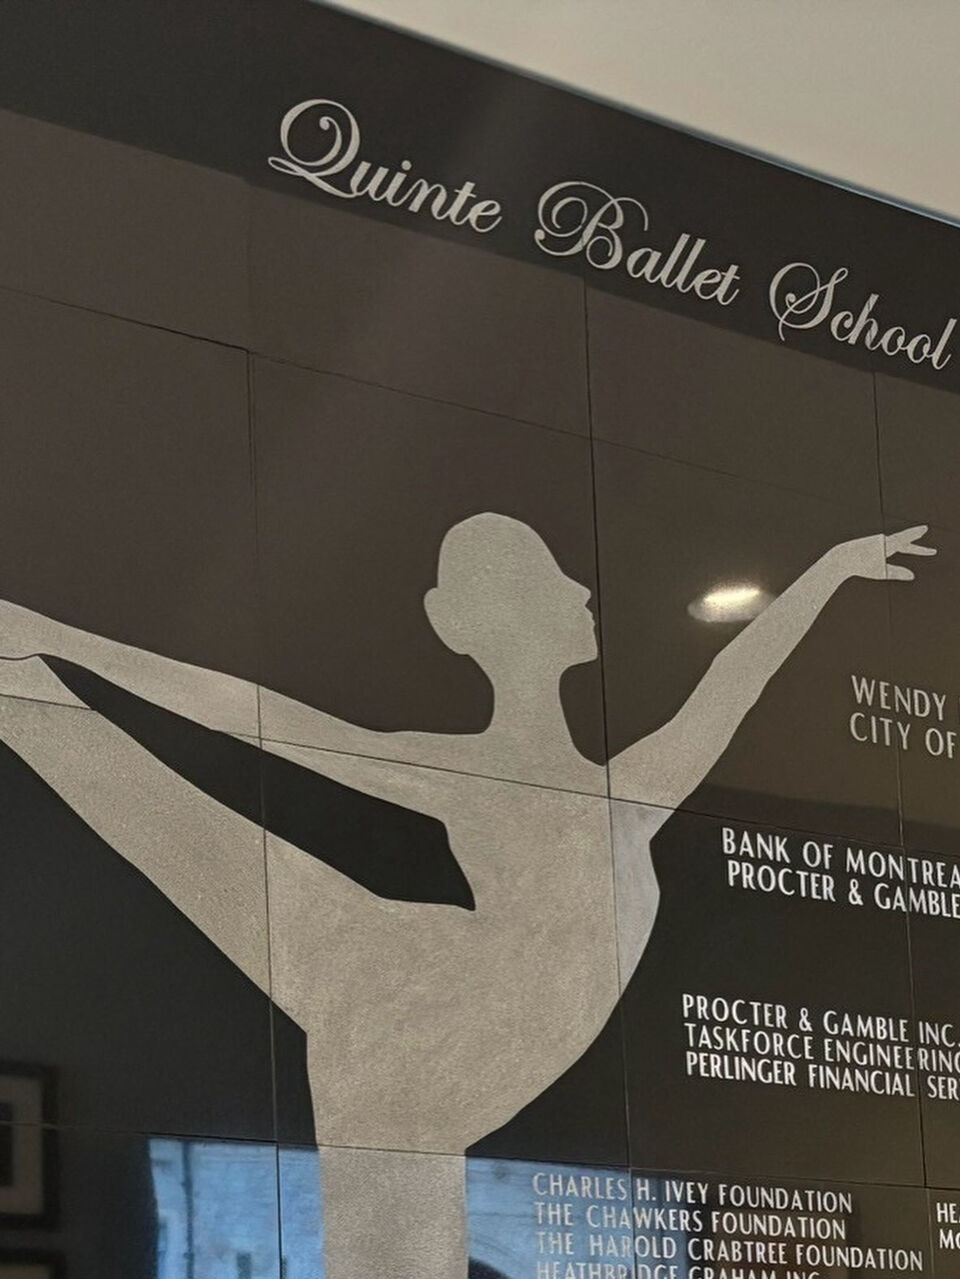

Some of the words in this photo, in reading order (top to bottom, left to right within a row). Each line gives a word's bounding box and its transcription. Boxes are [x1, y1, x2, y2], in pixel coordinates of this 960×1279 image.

[268, 99, 501, 233] Quinte
[534, 181, 739, 305] Ballet
[769, 262, 957, 370] School
[852, 675, 946, 721] WENDY
[850, 713, 910, 750] CITY
[925, 727, 957, 759] OF
[722, 827, 790, 864] BANK
[803, 840, 833, 870] OF
[728, 861, 835, 901] PROCTER
[849, 878, 863, 905] &
[682, 994, 788, 1029] PROCTER
[799, 1006, 811, 1031] &
[824, 1009, 908, 1042] GAMBLE
[684, 1023, 813, 1059] TASKFORCE
[686, 1052, 796, 1085] PERLINGER
[808, 1063, 915, 1096] FINANCIAL
[533, 1173, 627, 1201] CHARLES
[637, 1179, 656, 1202] H.
[665, 1181, 710, 1205] IVEY
[719, 1184, 852, 1214] FOUNDATION
[535, 1202, 573, 1227] THE
[586, 1205, 702, 1233] CHAWKERS
[711, 1212, 846, 1240] FOUNDATION
